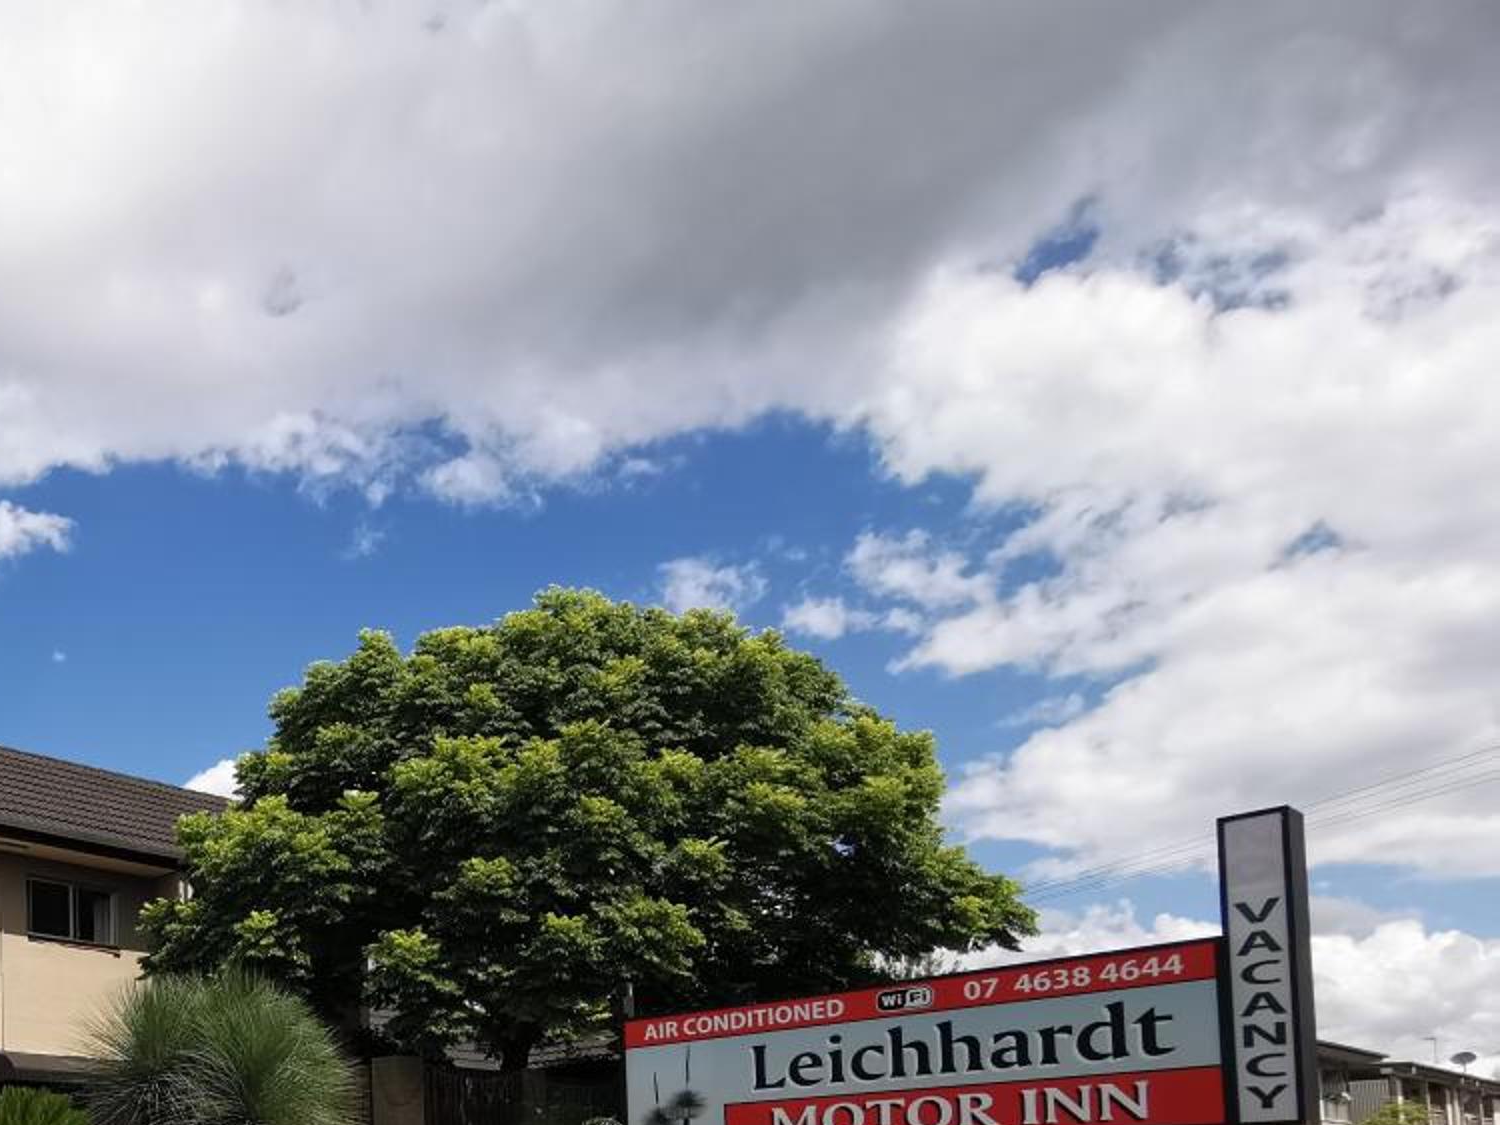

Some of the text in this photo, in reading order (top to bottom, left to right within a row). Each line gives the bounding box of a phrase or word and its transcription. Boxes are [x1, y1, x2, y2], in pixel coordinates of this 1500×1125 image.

[644, 1021, 678, 1041] AIR
[683, 999, 845, 1036] CONDITIONED
[964, 978, 998, 1000] 07
[1013, 967, 1091, 993] 4638
[1099, 954, 1184, 983] 4644
[1234, 897, 1288, 1109] VACANCY
[751, 1001, 1177, 1091] Leichhardt
[1021, 1080, 1150, 1125] INN
